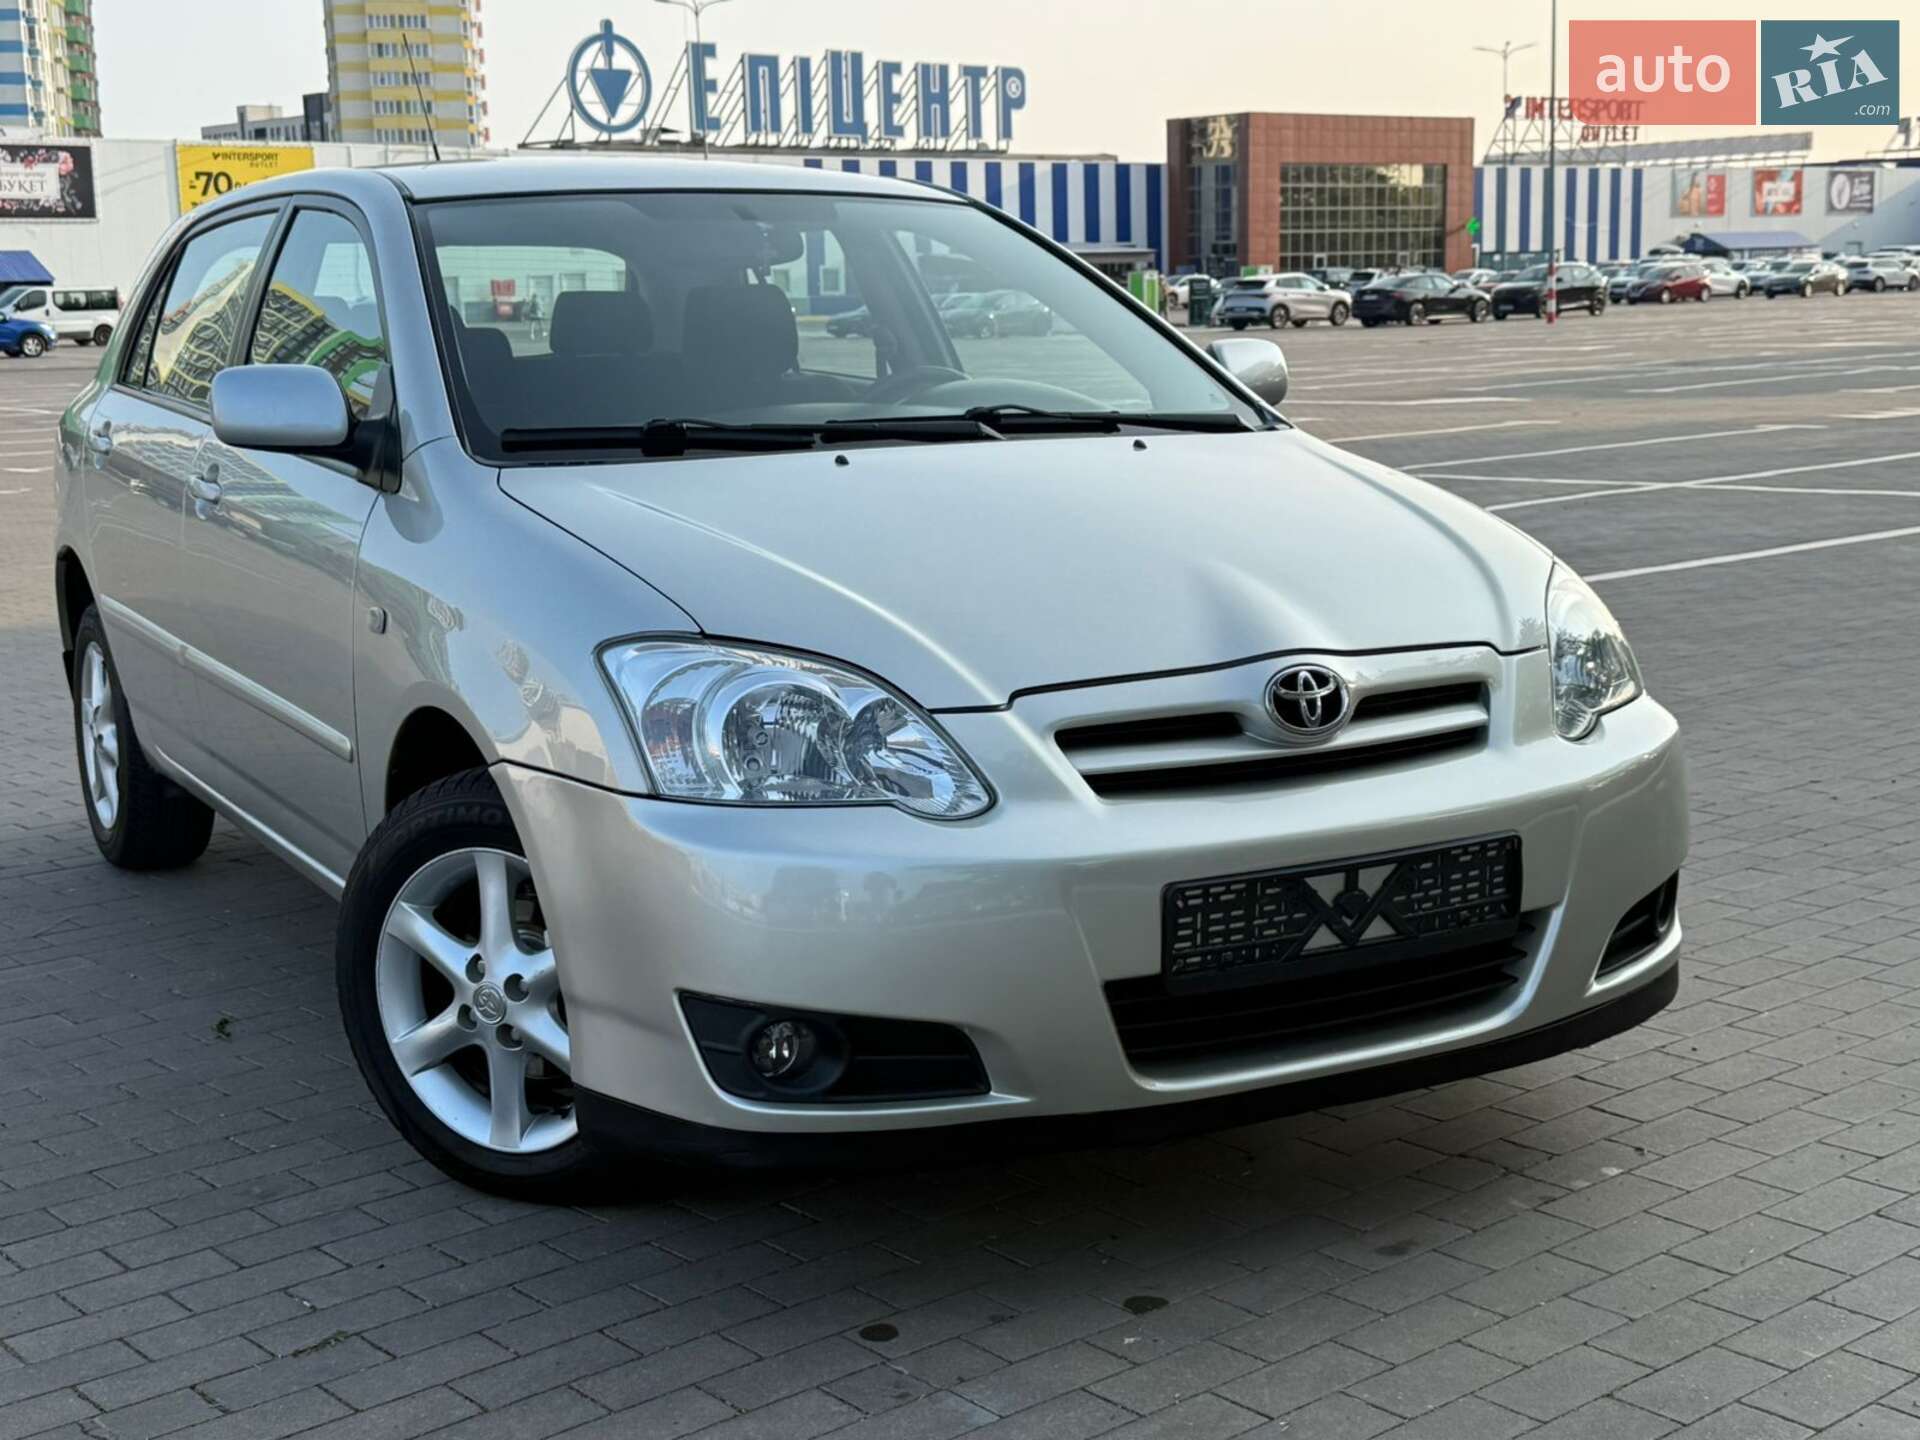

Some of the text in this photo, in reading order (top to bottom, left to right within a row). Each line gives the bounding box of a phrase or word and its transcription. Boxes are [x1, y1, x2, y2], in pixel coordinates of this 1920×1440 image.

[686, 41, 1026, 144] ЕПІЦЕНТР
[1581, 125, 1638, 142] OUTLET
[221, 151, 278, 161] INTERSPORT
